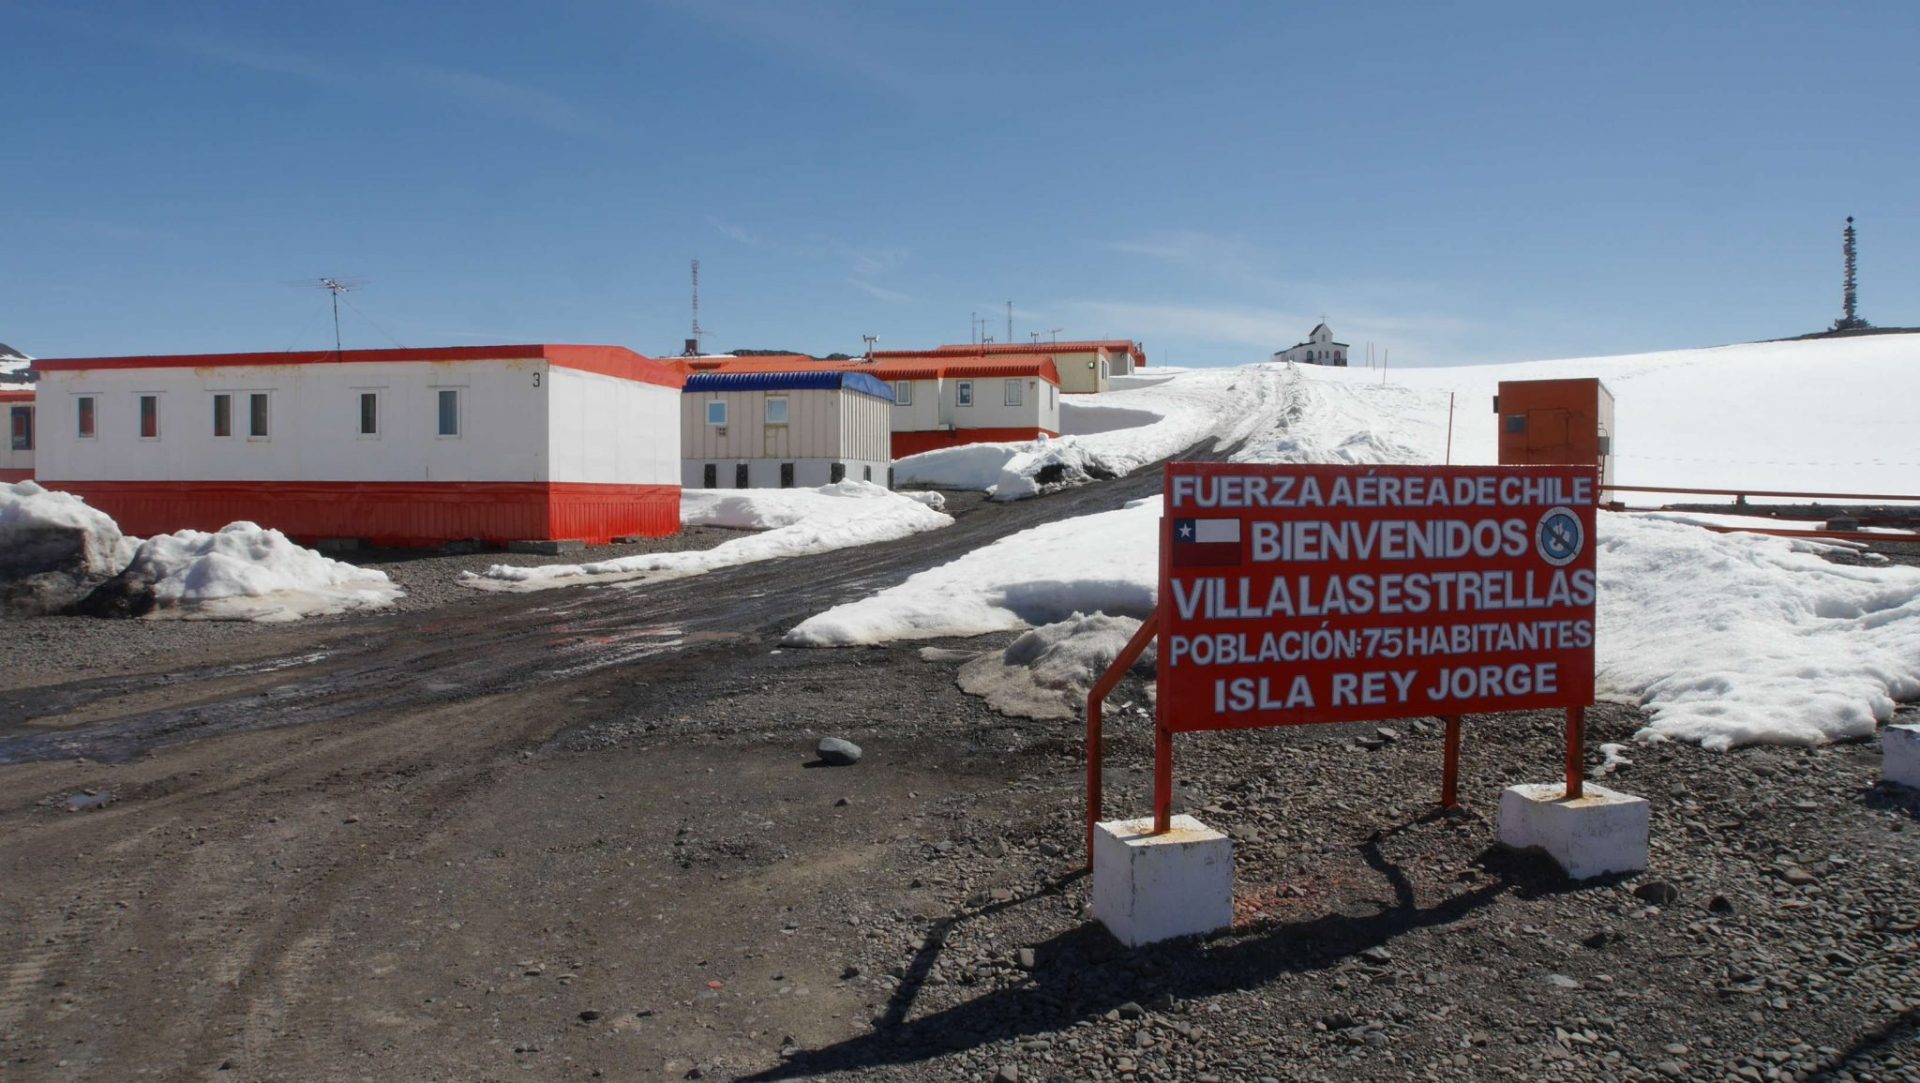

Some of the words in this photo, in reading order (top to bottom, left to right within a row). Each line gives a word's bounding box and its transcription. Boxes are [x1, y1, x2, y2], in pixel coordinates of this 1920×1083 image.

[532, 372, 540, 388] 3
[1172, 475, 1325, 507] FUERZA
[1327, 469, 1450, 507] AÉREA
[1453, 476, 1496, 506] DE
[1499, 476, 1592, 506] CHILE
[1251, 518, 1529, 563] BIENVENIDOS
[1170, 576, 1296, 620] VILLA
[1299, 573, 1376, 616] LAS
[1379, 568, 1596, 614] ESTRELLAS
[1170, 621, 1361, 667] POBLACIÓN:
[1362, 627, 1403, 659] 75
[1406, 619, 1593, 656] HABITANTES
[1214, 674, 1316, 713] ISLA
[1331, 669, 1419, 706] REY
[1426, 662, 1558, 700] JORGE
